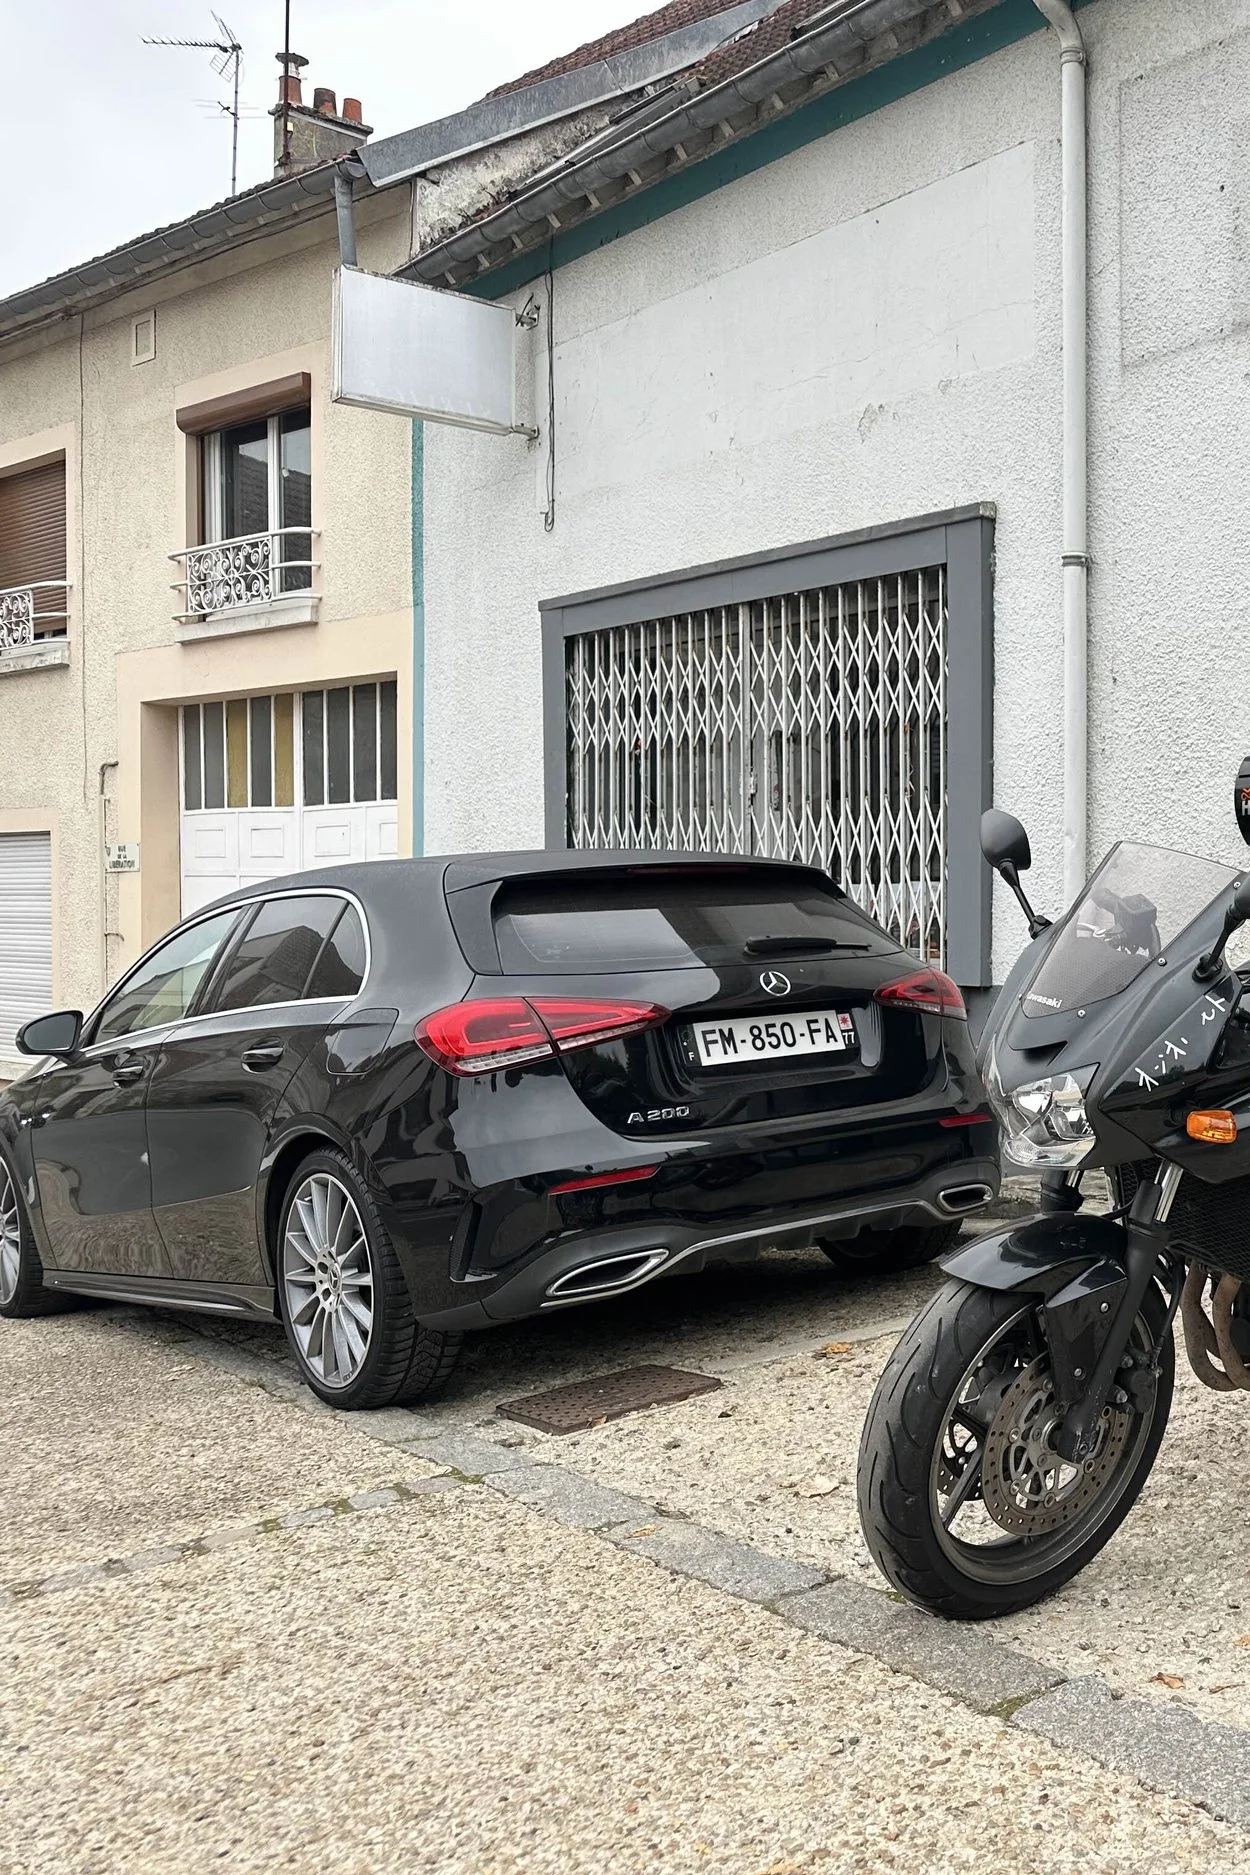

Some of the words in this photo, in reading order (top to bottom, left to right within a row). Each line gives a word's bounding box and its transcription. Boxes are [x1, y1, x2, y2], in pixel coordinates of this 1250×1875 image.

[1241, 800, 1250, 816] H
[688, 1051, 695, 1062] F
[701, 1017, 838, 1058] FM-850-FA
[843, 1031, 856, 1045] 77
[627, 1112, 645, 1124] A
[647, 1106, 690, 1121] 200
